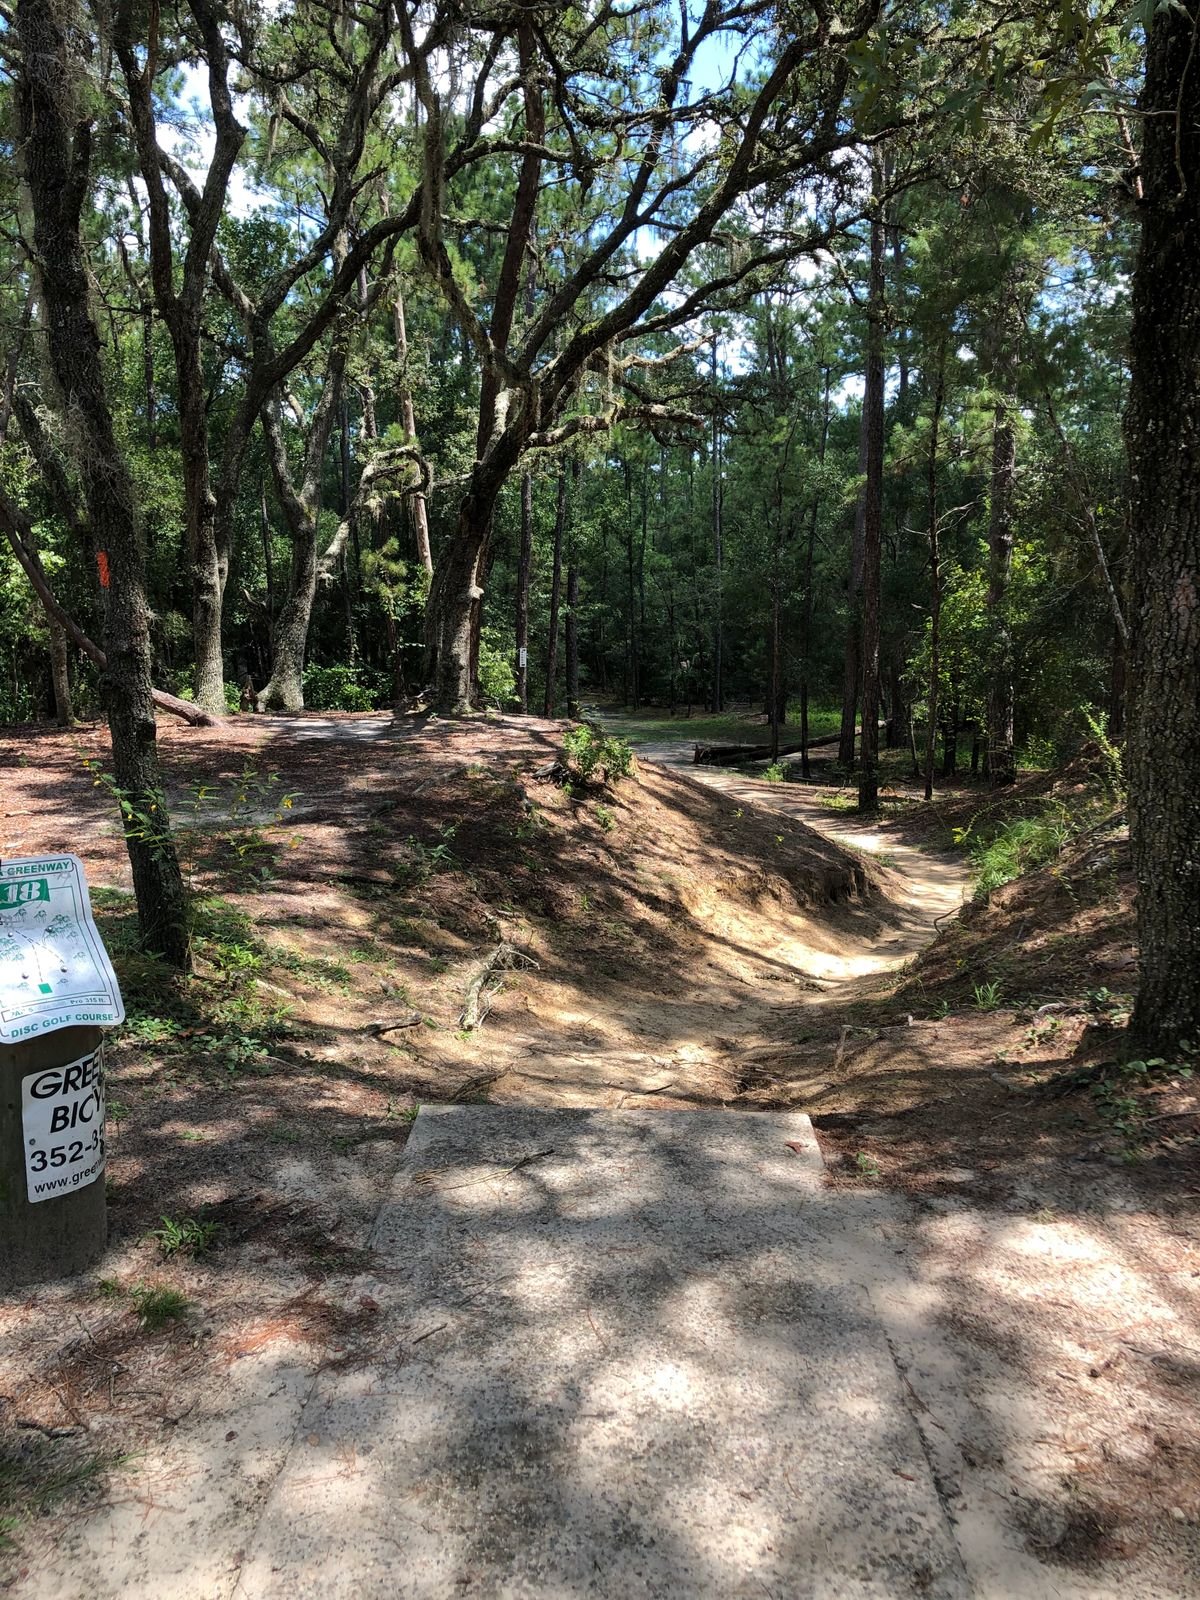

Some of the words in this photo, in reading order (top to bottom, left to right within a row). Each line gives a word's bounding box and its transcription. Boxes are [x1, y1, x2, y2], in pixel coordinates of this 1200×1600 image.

[7, 861, 70, 876] GREENWAY
[3, 881, 41, 904] 18
[10, 1023, 39, 1039] DISC
[42, 1014, 72, 1028] GOLF
[75, 1013, 114, 1021] COURSE
